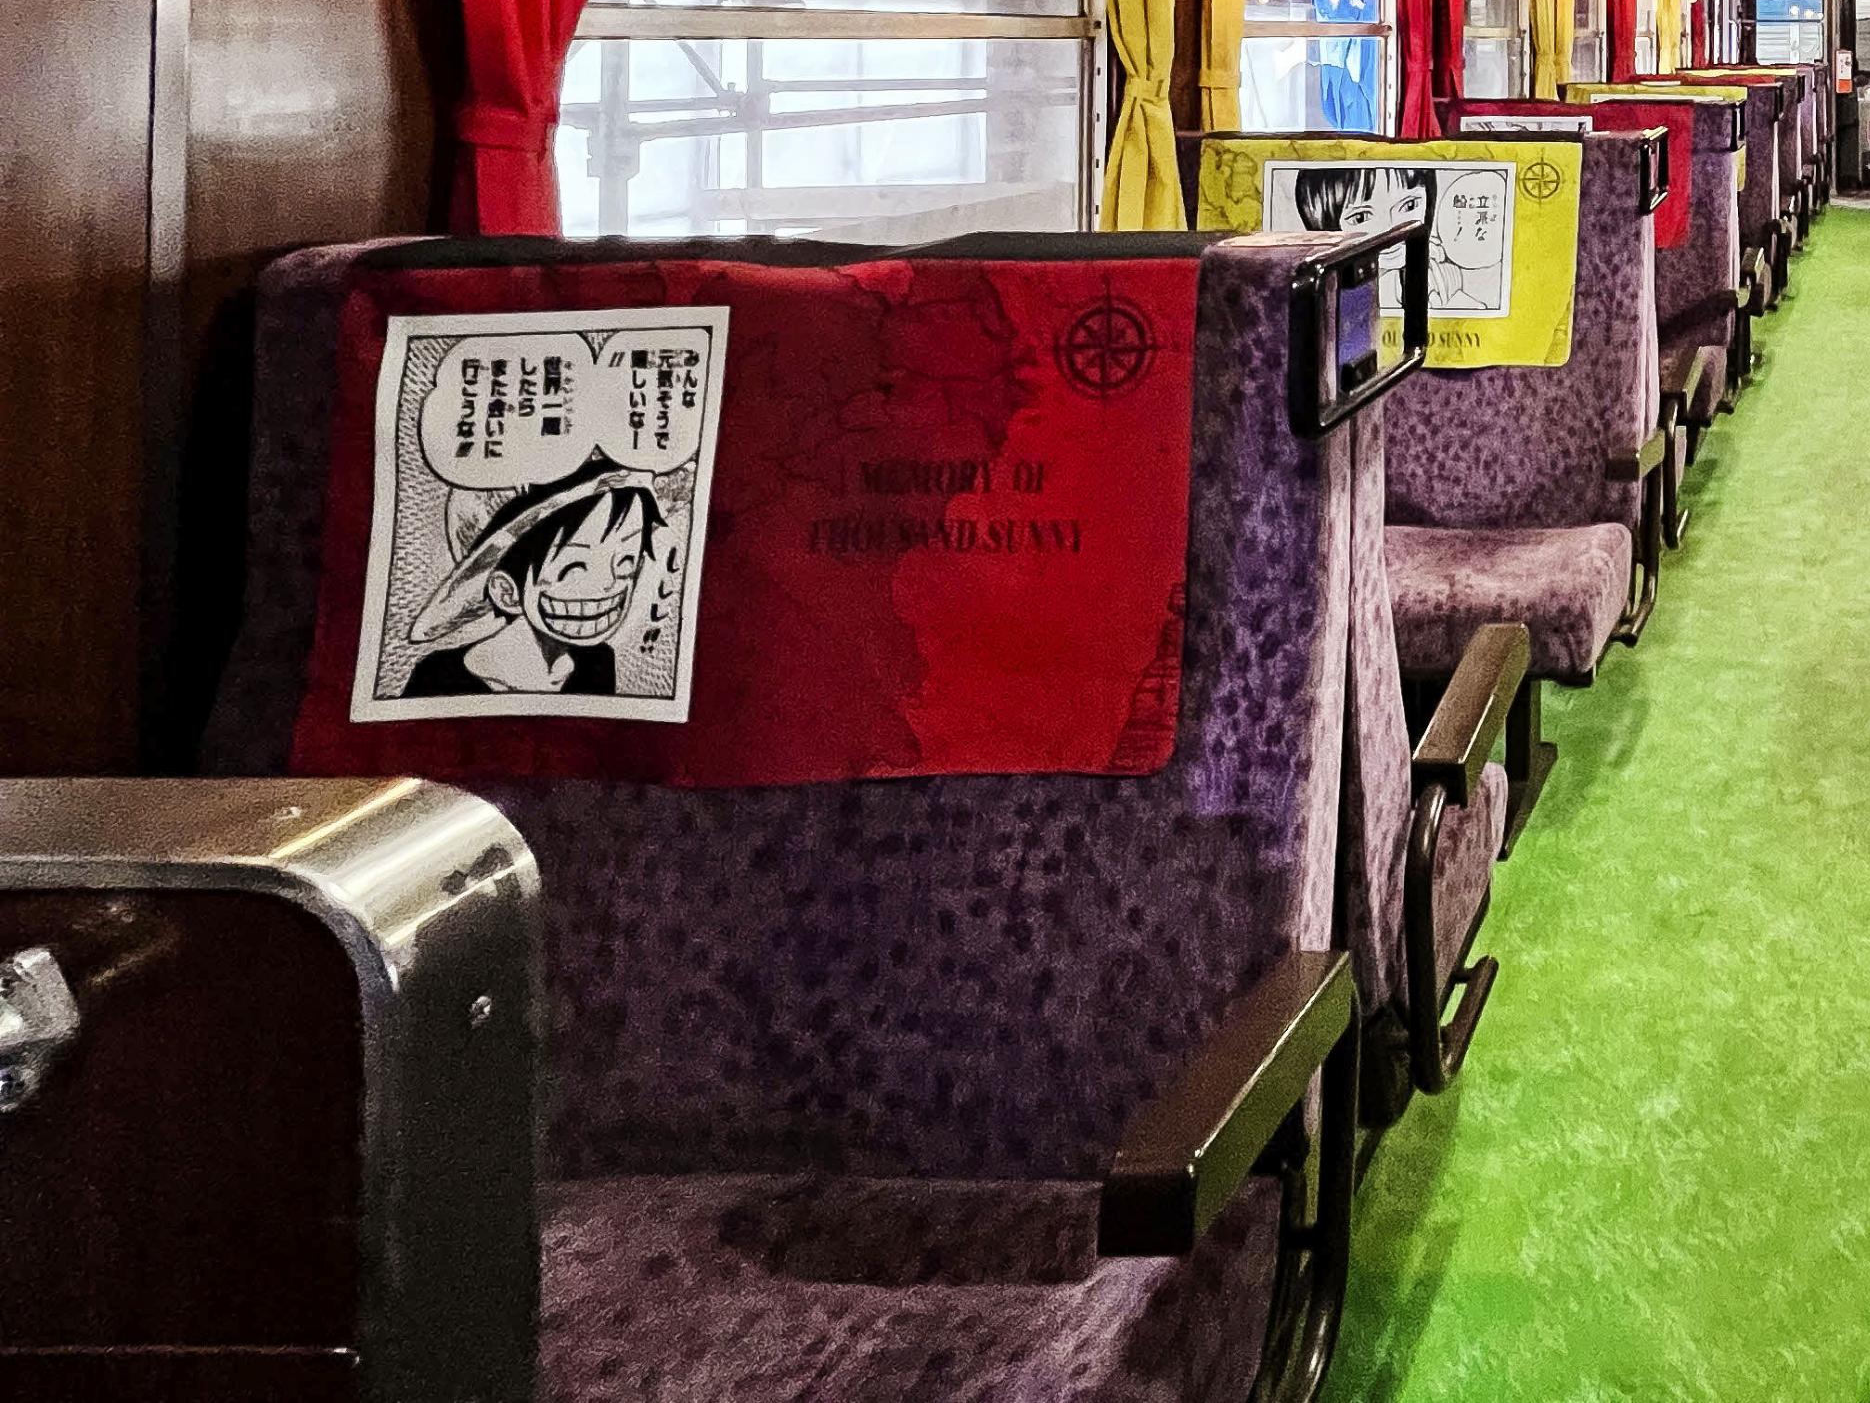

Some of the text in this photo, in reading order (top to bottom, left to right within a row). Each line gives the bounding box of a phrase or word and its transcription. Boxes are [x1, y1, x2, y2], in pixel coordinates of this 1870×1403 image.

[518, 357, 538, 418] したら
[682, 349, 700, 409] みんな
